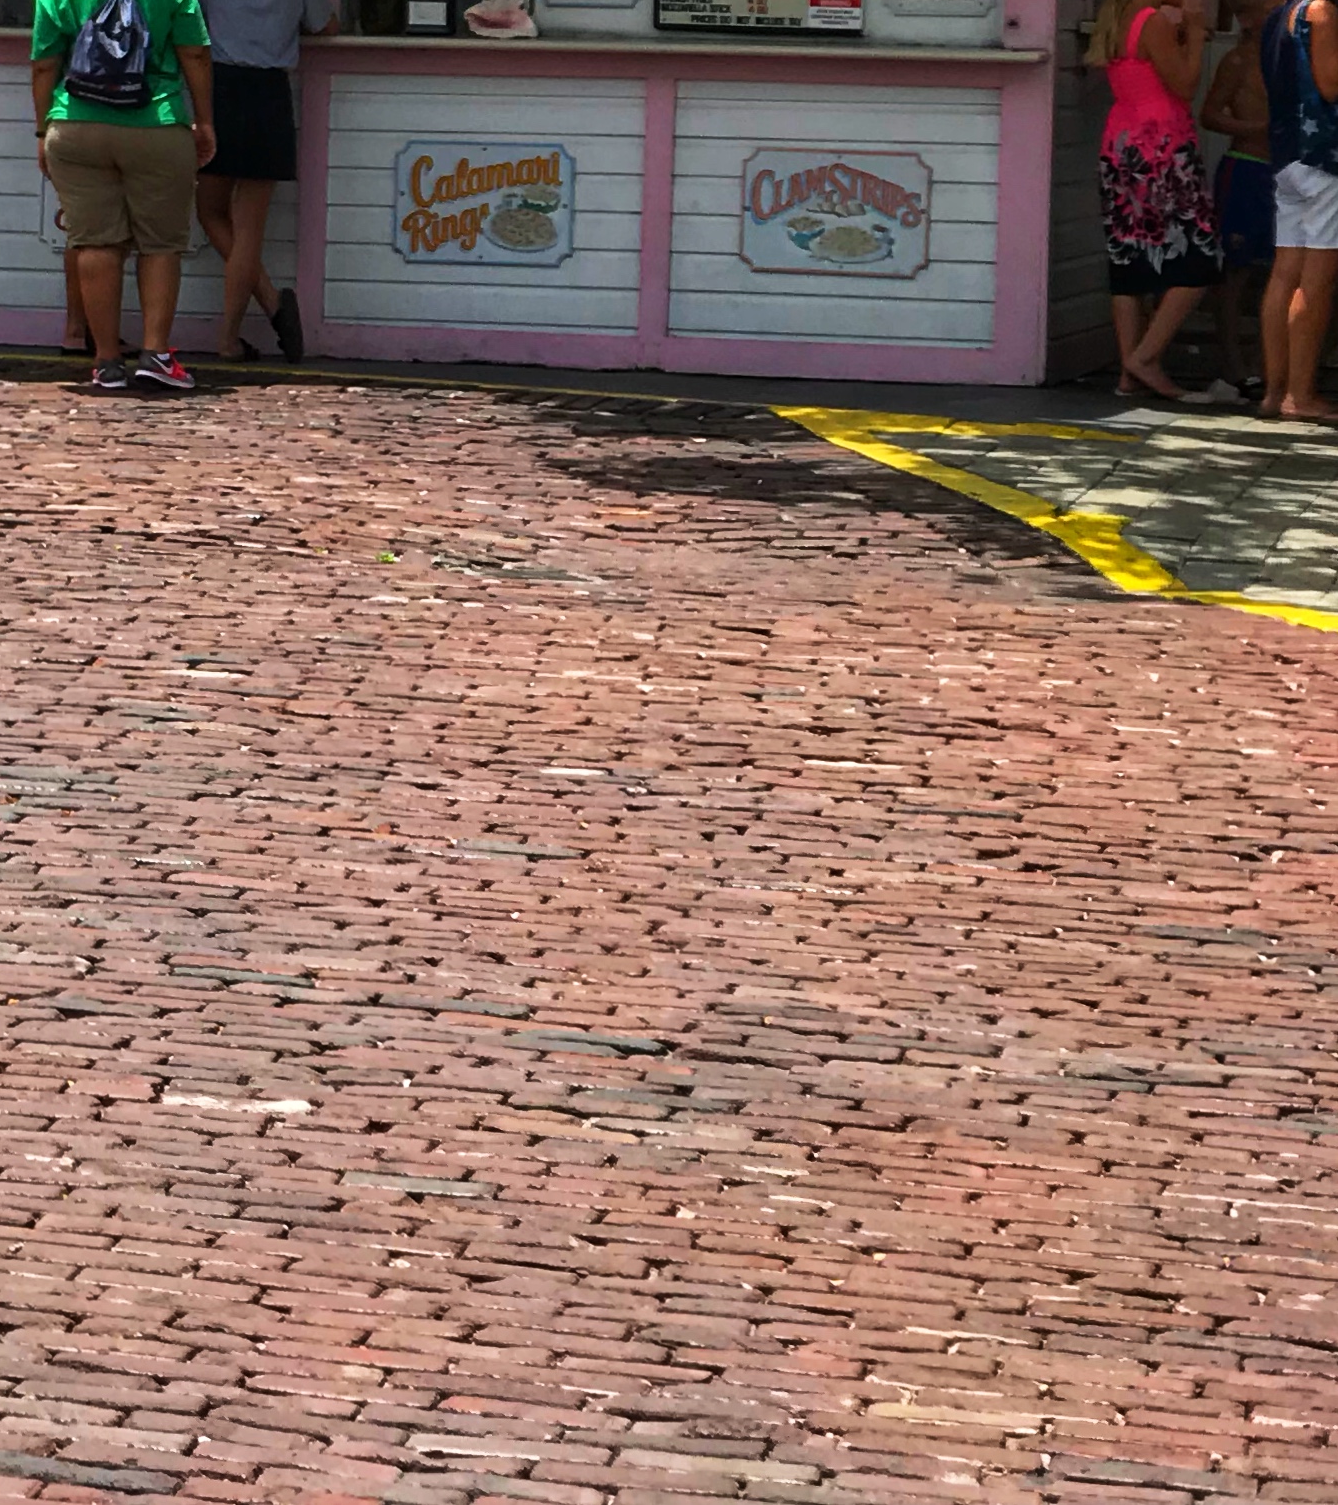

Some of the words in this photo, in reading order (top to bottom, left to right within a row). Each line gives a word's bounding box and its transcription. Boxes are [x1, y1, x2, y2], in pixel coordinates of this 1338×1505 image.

[410, 151, 563, 208] Calamari
[752, 166, 827, 220] CLAM
[826, 163, 923, 228] STRIPS
